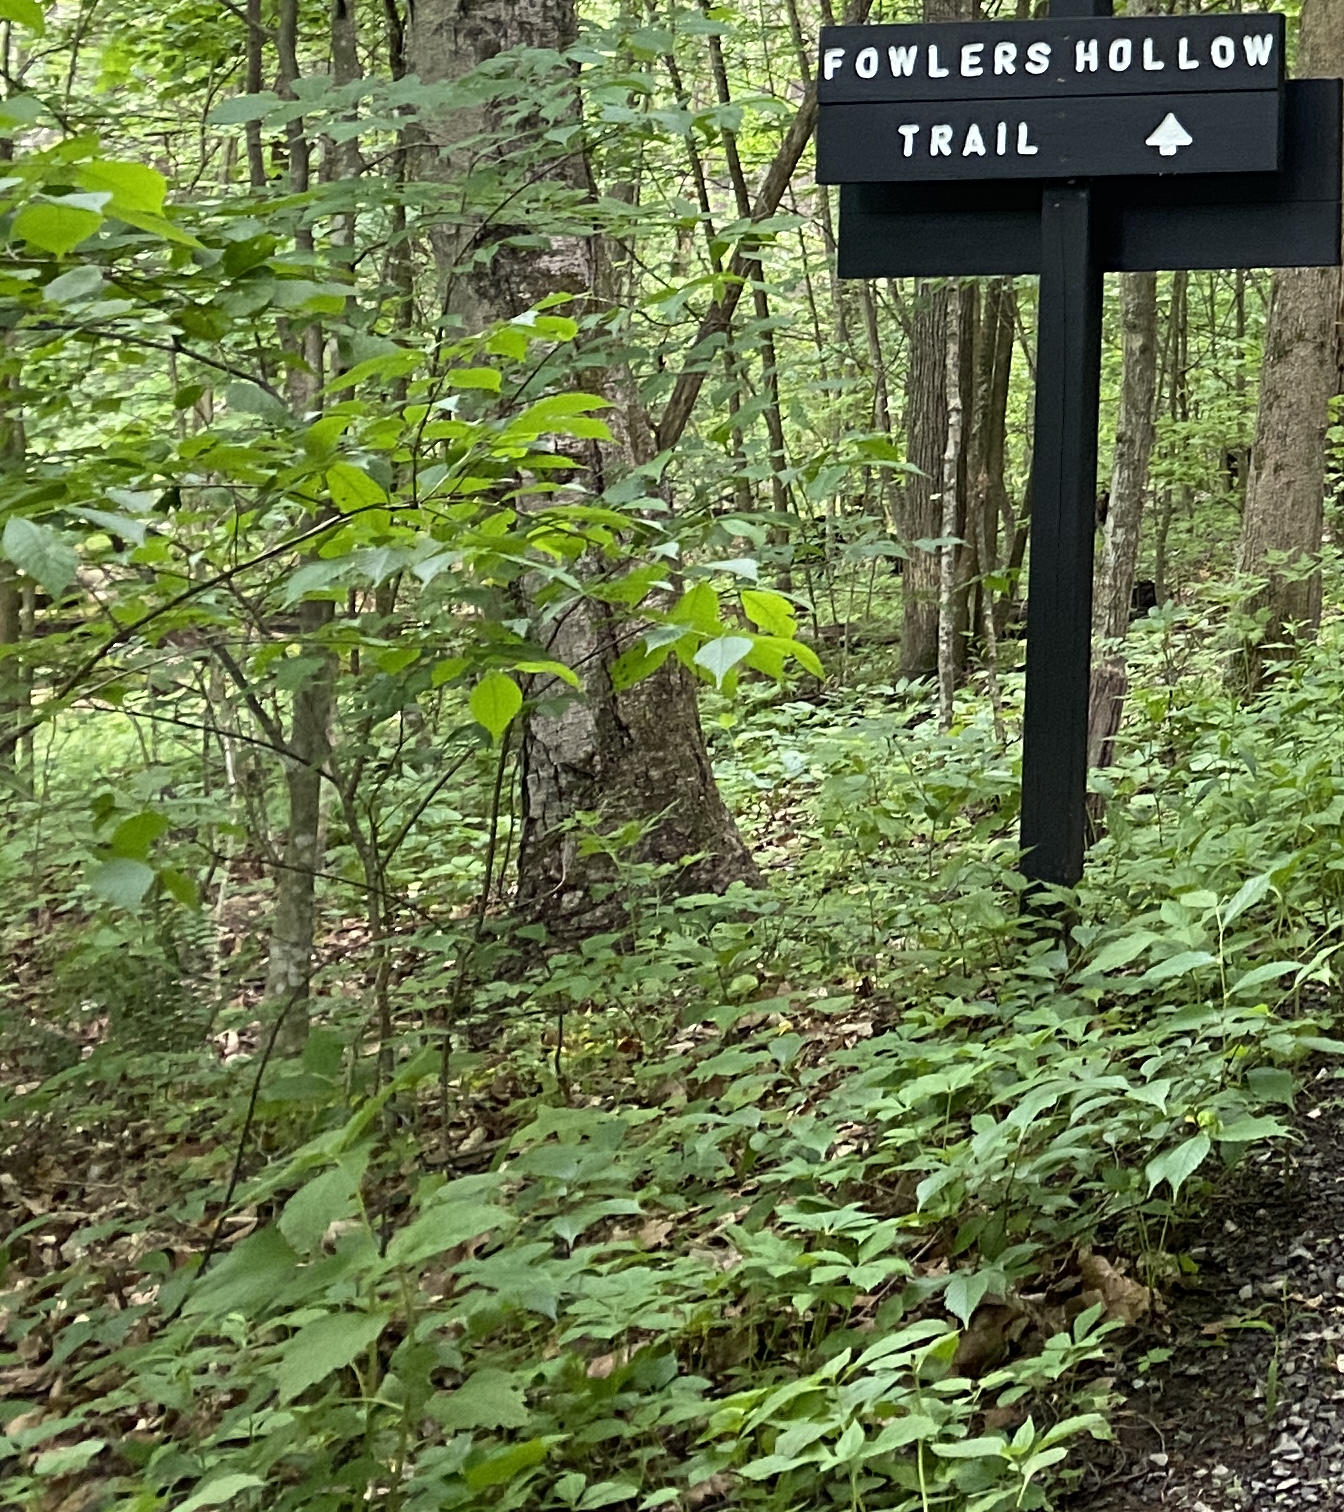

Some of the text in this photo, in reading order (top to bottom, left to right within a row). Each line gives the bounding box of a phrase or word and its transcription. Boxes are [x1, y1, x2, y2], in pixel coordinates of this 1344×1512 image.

[823, 33, 1275, 81] FOWLERS HOLLOW
[897, 121, 1039, 158] TRAIL
